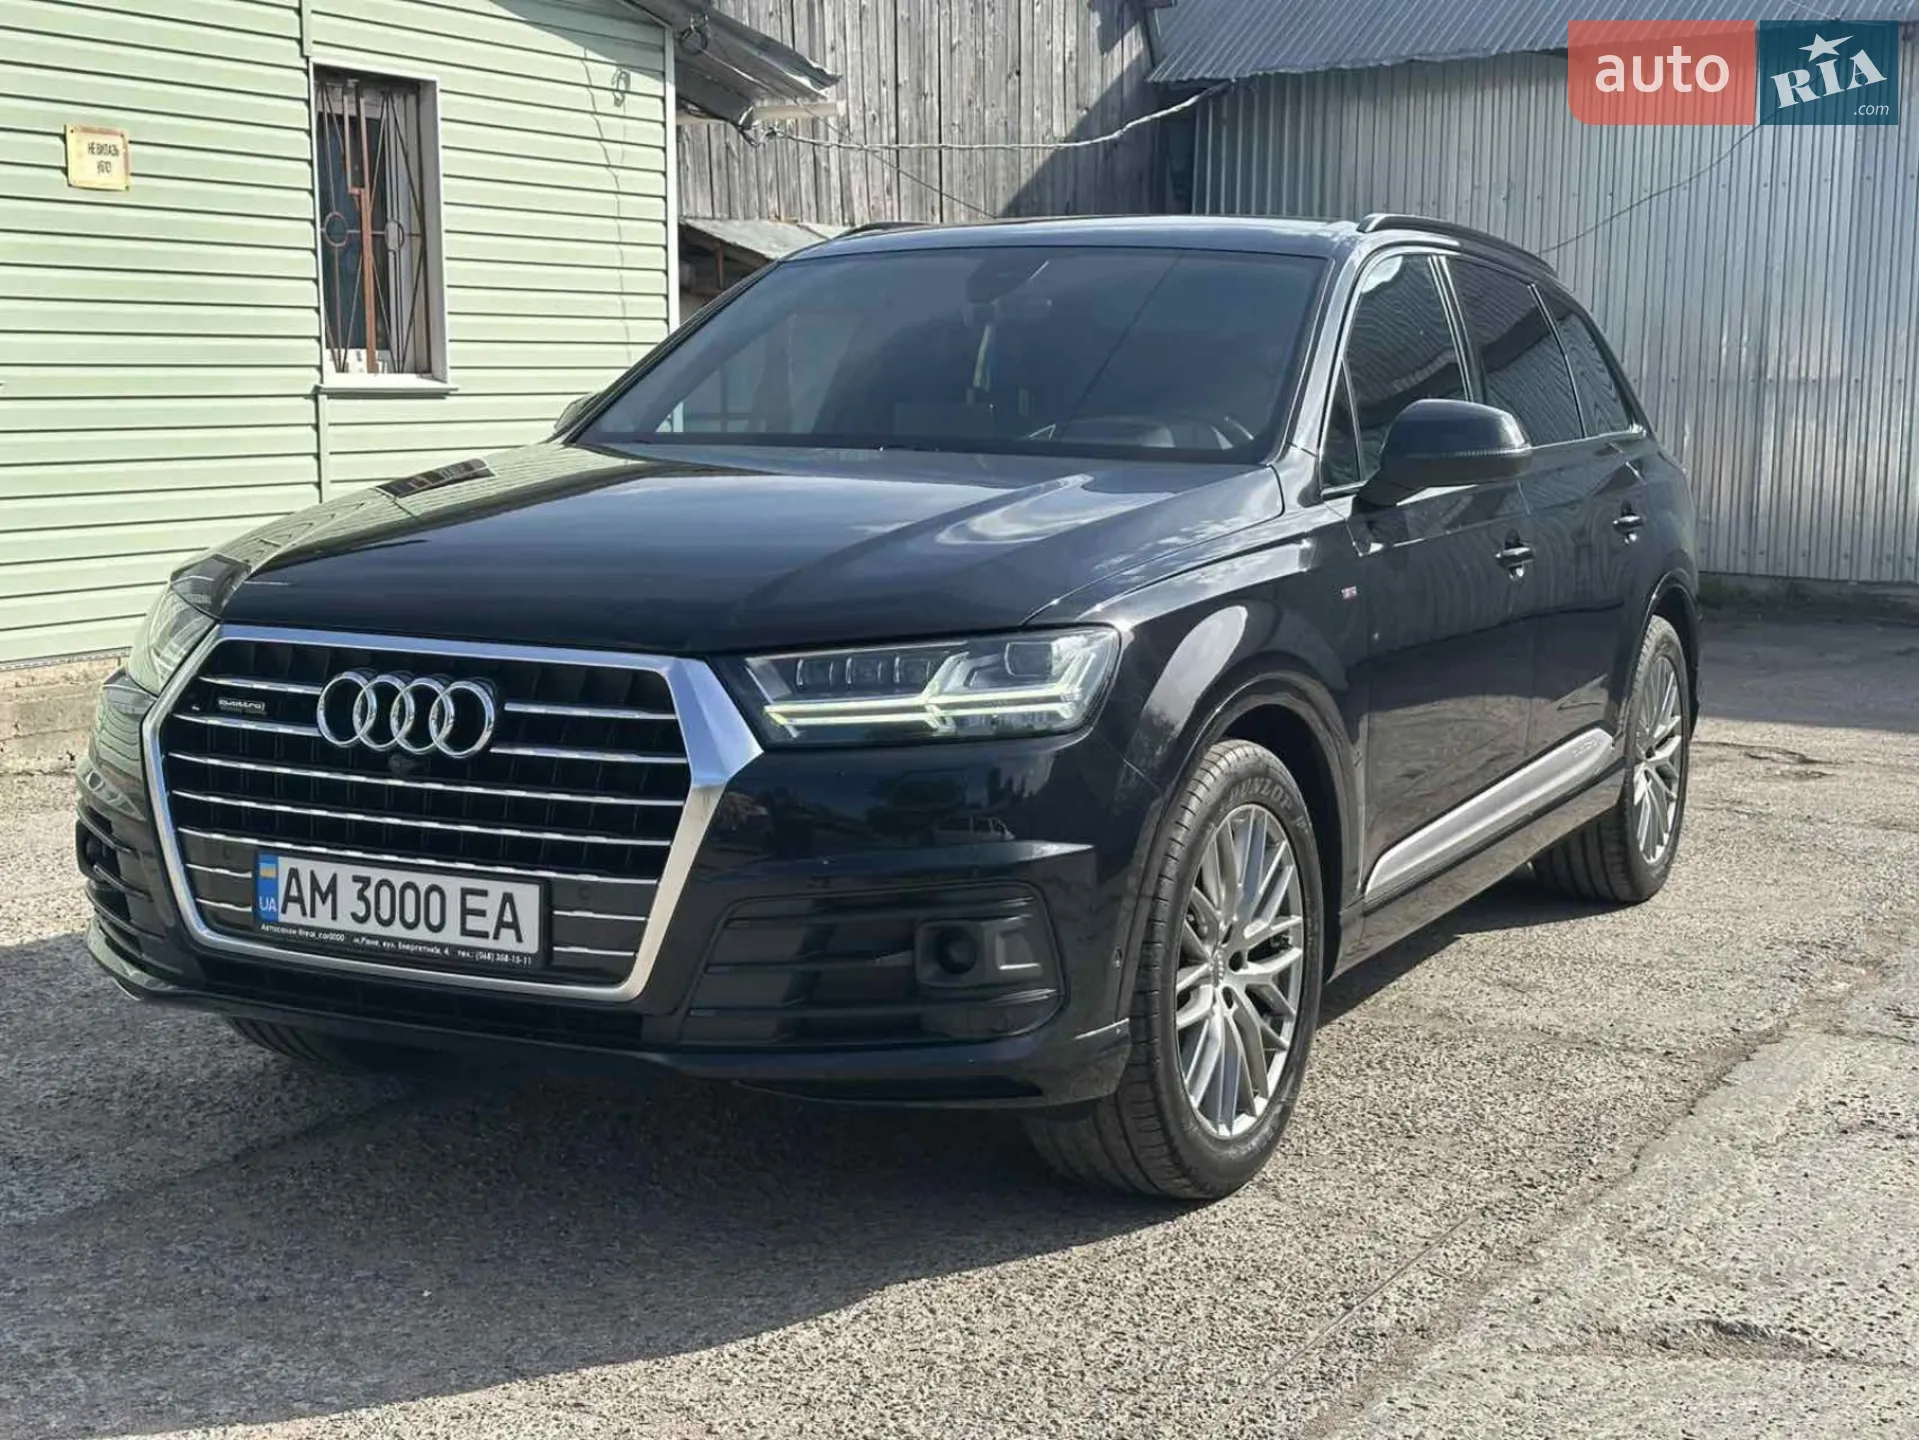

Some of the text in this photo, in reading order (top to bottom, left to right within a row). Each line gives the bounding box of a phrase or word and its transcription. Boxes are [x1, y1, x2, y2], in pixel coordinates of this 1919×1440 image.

[260, 896, 277, 912] UA
[281, 867, 523, 943] AM 3000 EA
